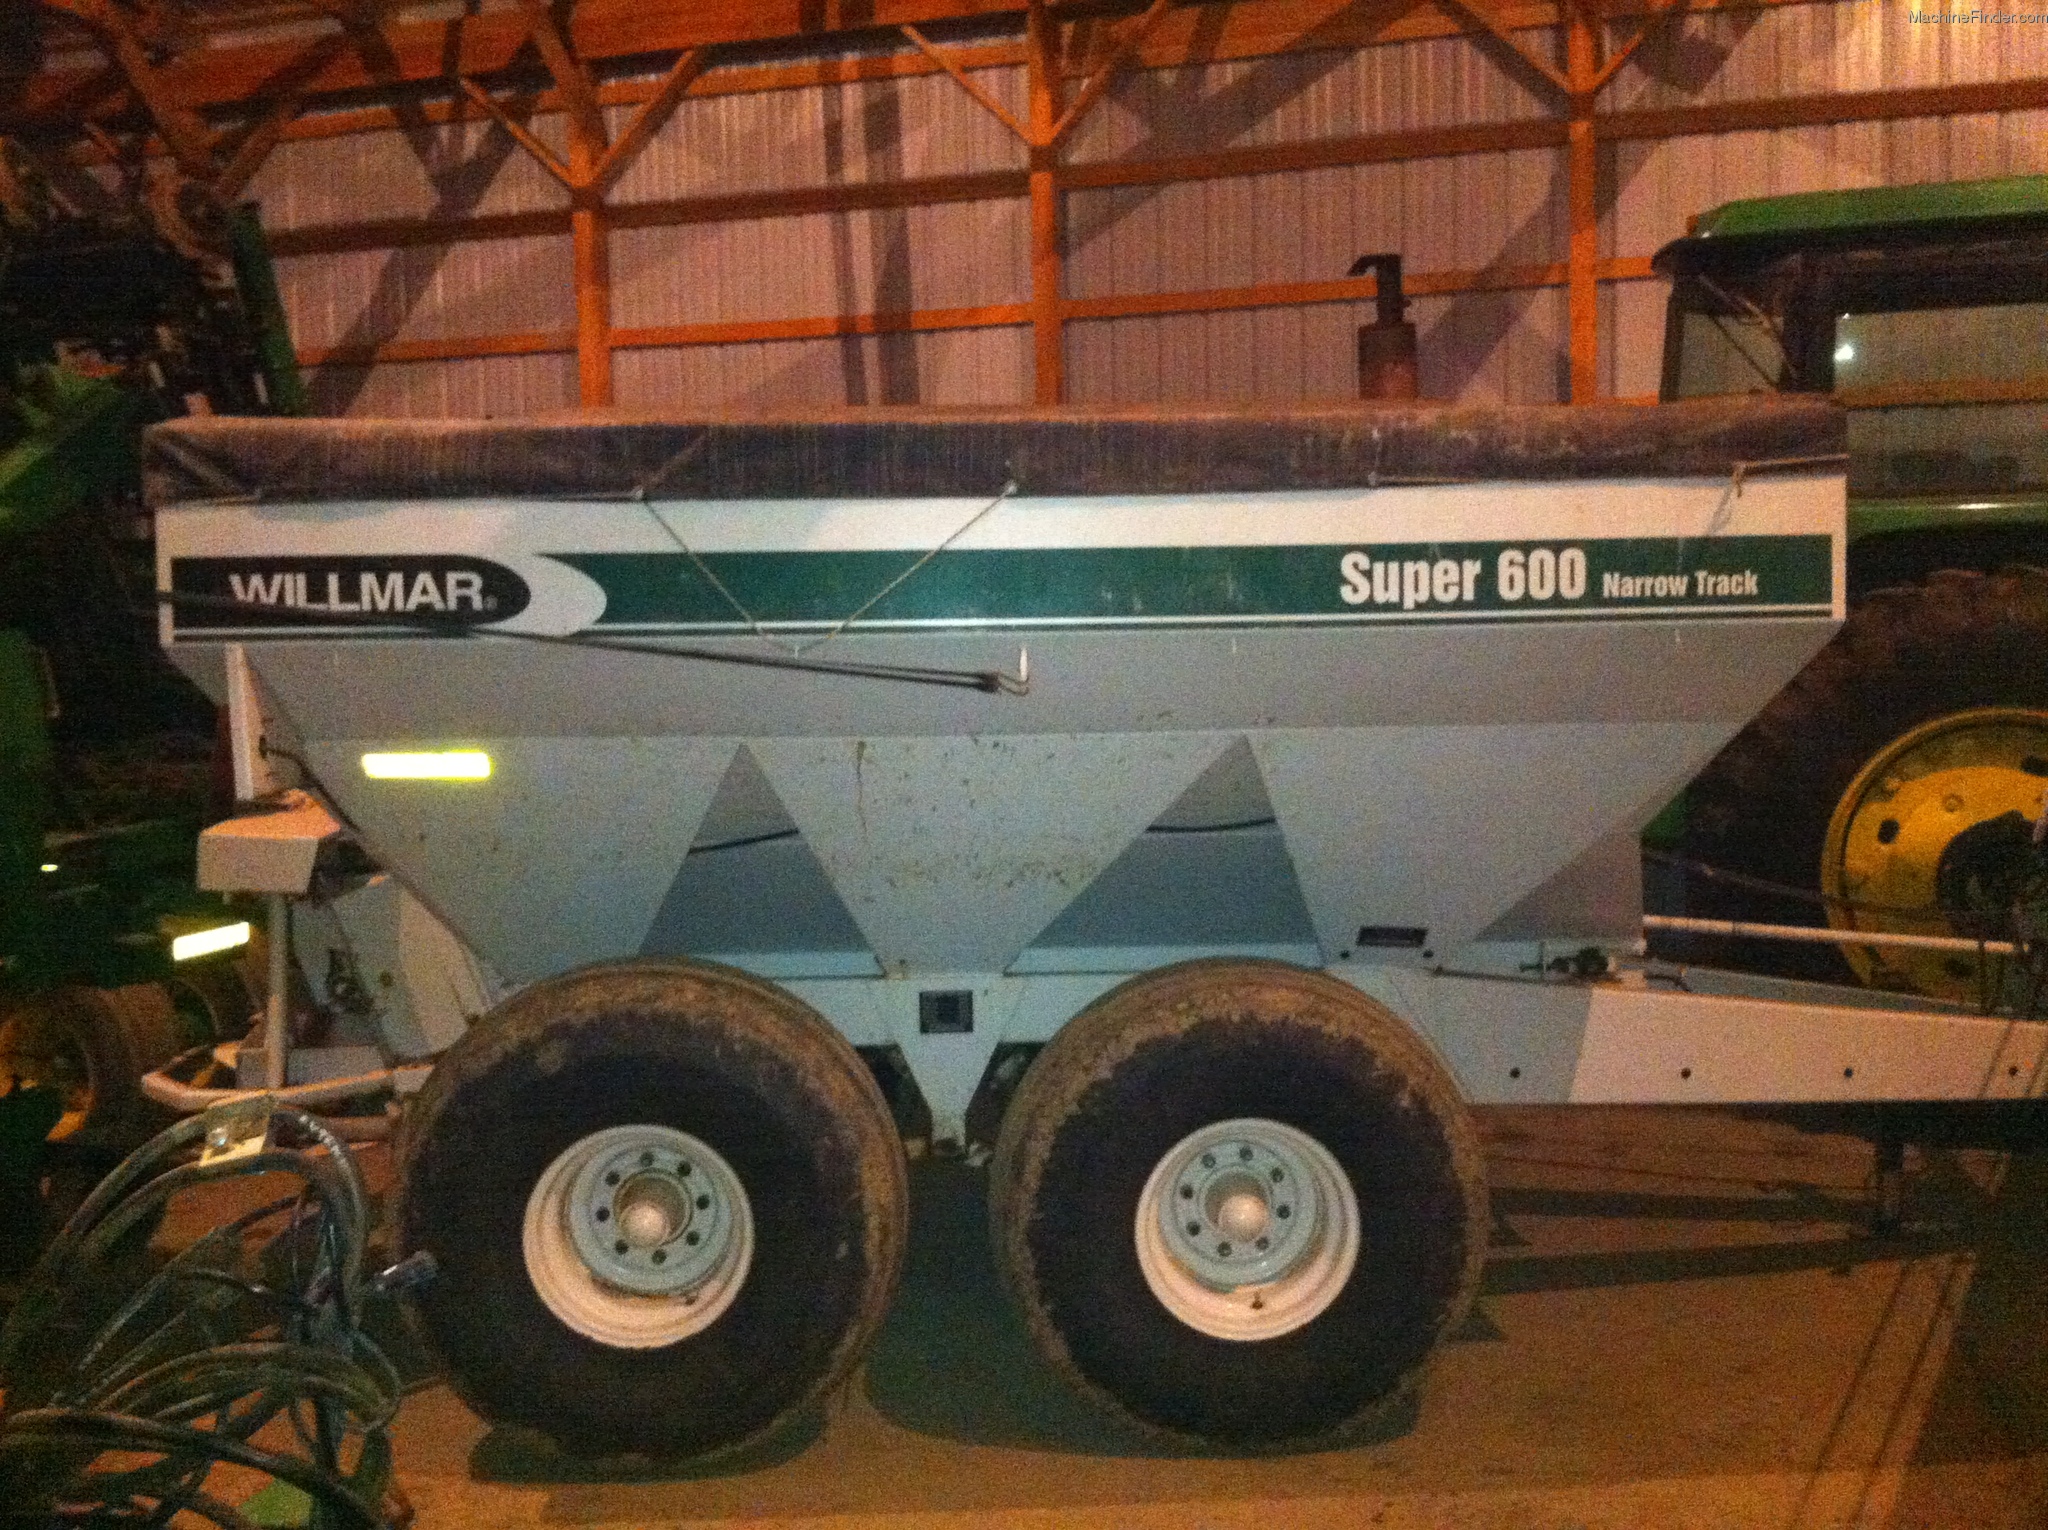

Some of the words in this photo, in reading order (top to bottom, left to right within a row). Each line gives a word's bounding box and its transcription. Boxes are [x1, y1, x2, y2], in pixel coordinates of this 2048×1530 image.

[229, 570, 485, 613] WILLMAR
[1340, 550, 1482, 610] Super
[1496, 547, 1587, 602] 600
[1602, 570, 1688, 600] Narrow
[1694, 568, 1760, 597] Track
